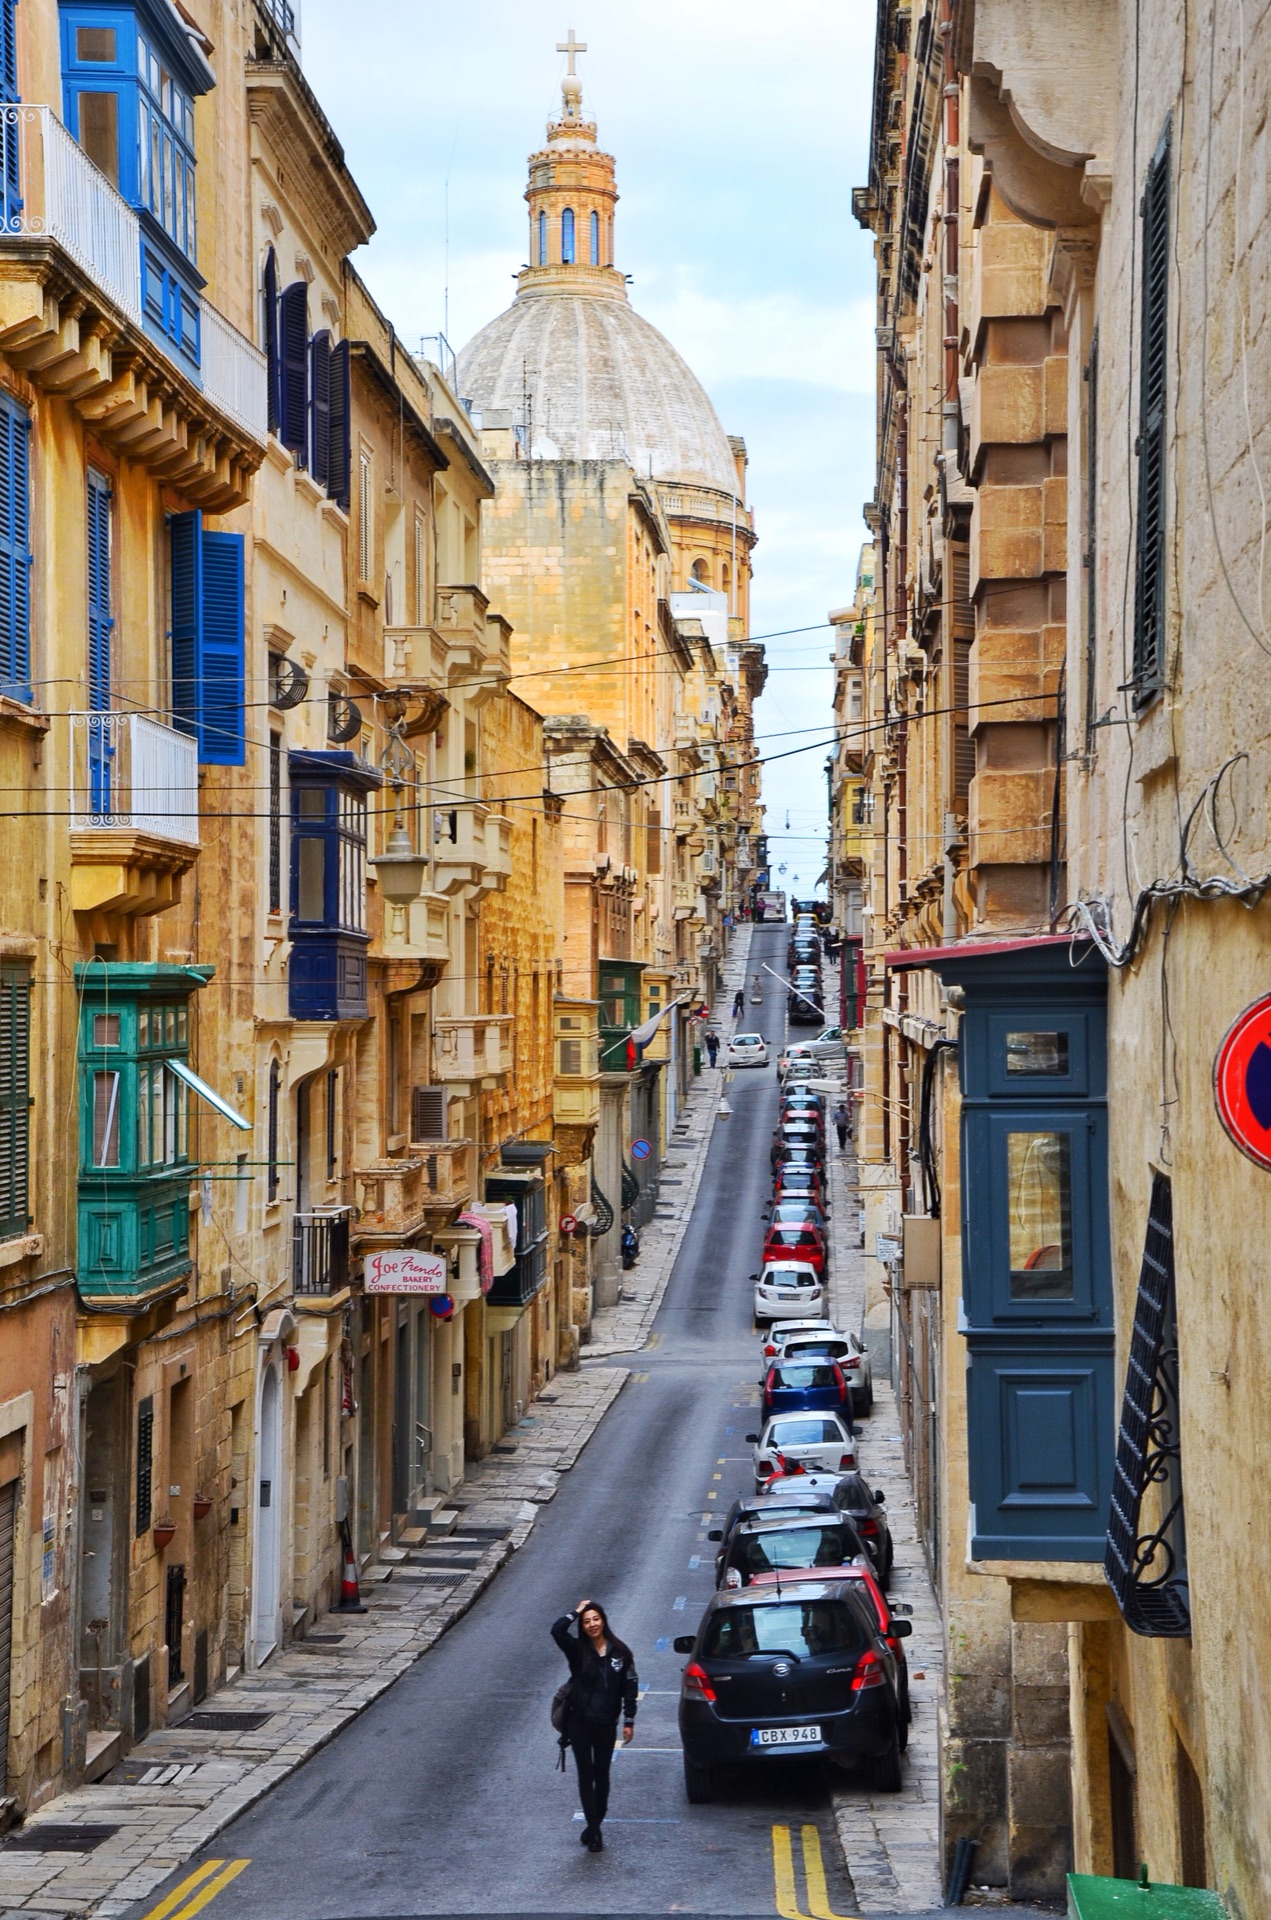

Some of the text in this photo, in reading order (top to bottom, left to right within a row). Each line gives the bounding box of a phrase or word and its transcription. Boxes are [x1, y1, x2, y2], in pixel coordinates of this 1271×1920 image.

[371, 1255, 442, 1283] Joe Frendo
[761, 1728, 817, 1742] CBX 948
